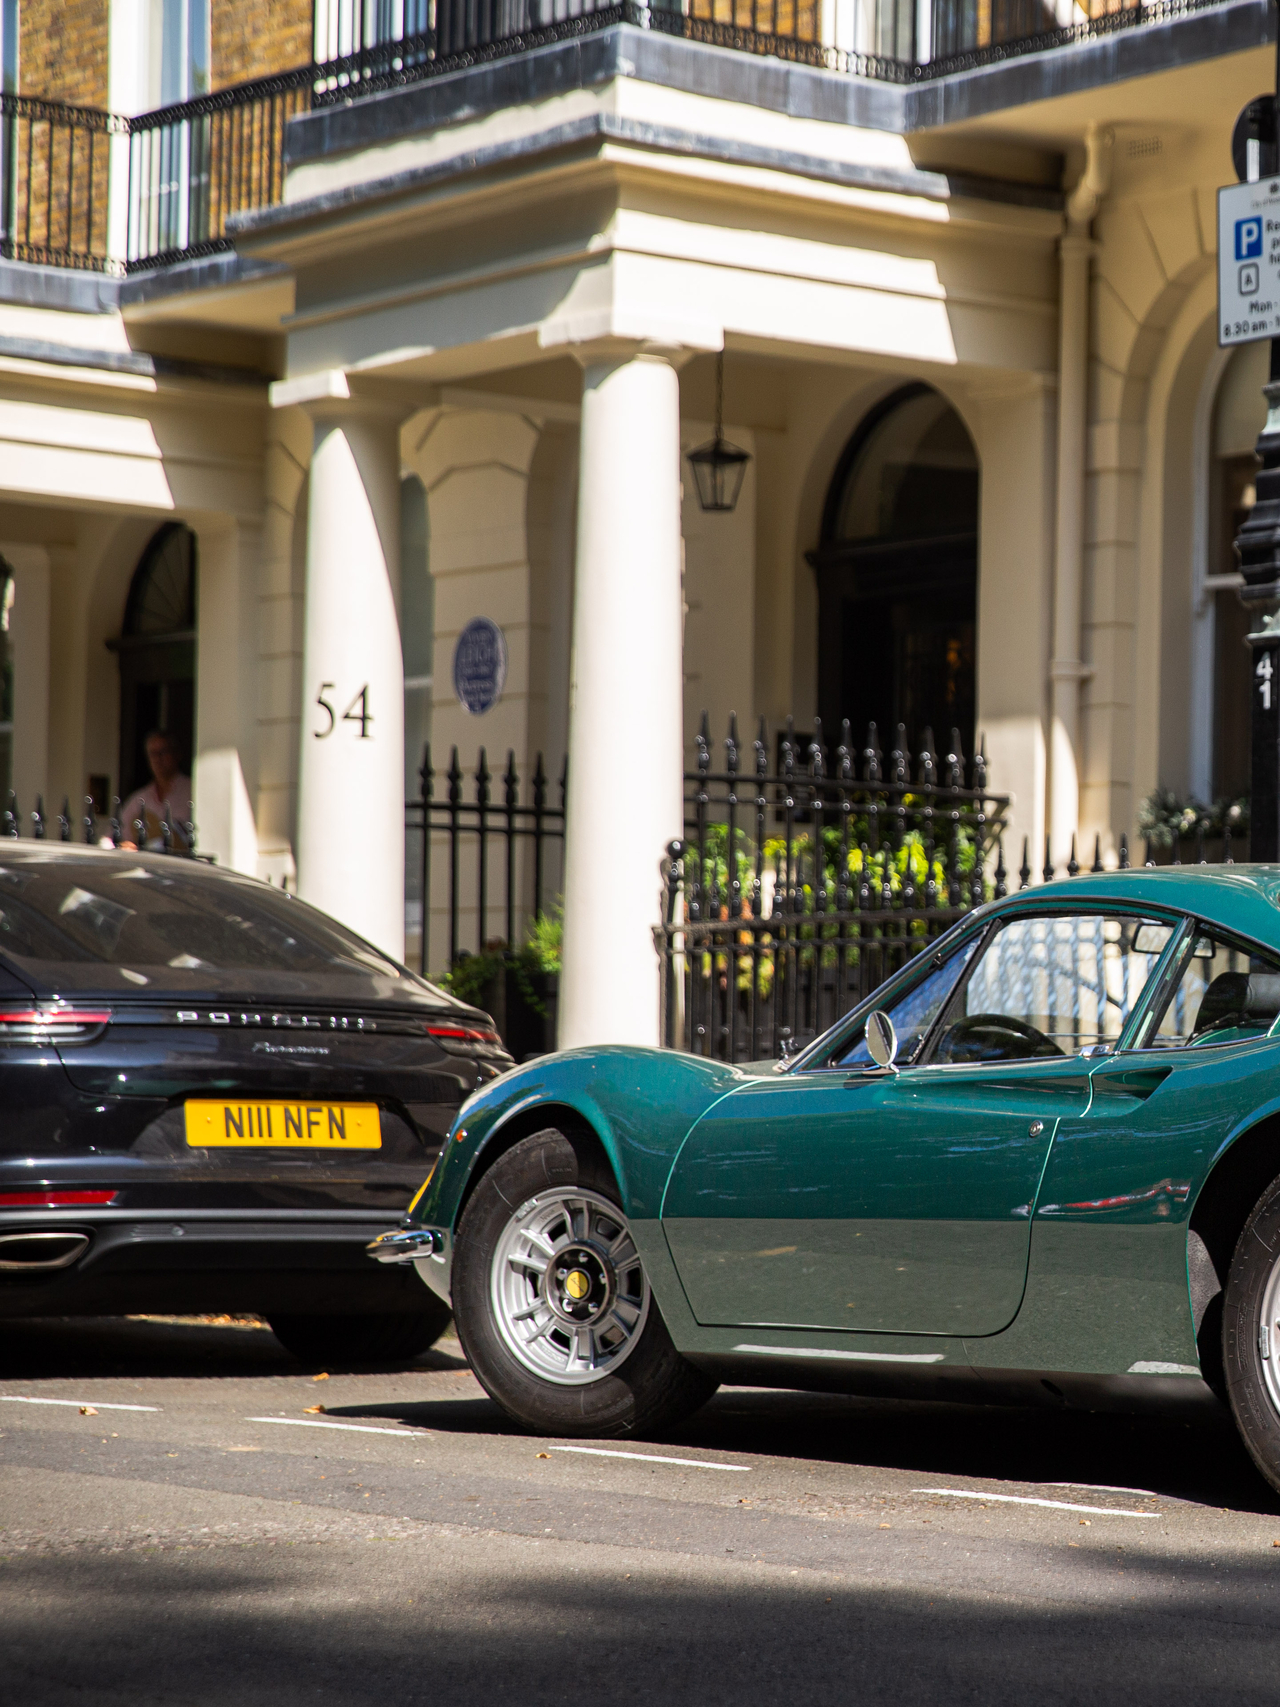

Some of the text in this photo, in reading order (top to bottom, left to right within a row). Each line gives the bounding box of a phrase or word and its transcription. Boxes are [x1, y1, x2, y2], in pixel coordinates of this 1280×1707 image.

[1241, 221, 1259, 256] P
[1244, 272, 1253, 286] A
[1249, 300, 1272, 314] Mon
[1223, 320, 1250, 338] 8.30
[1251, 320, 1268, 332] am
[313, 681, 374, 739] 54
[284, 1107, 346, 1140] NFN
